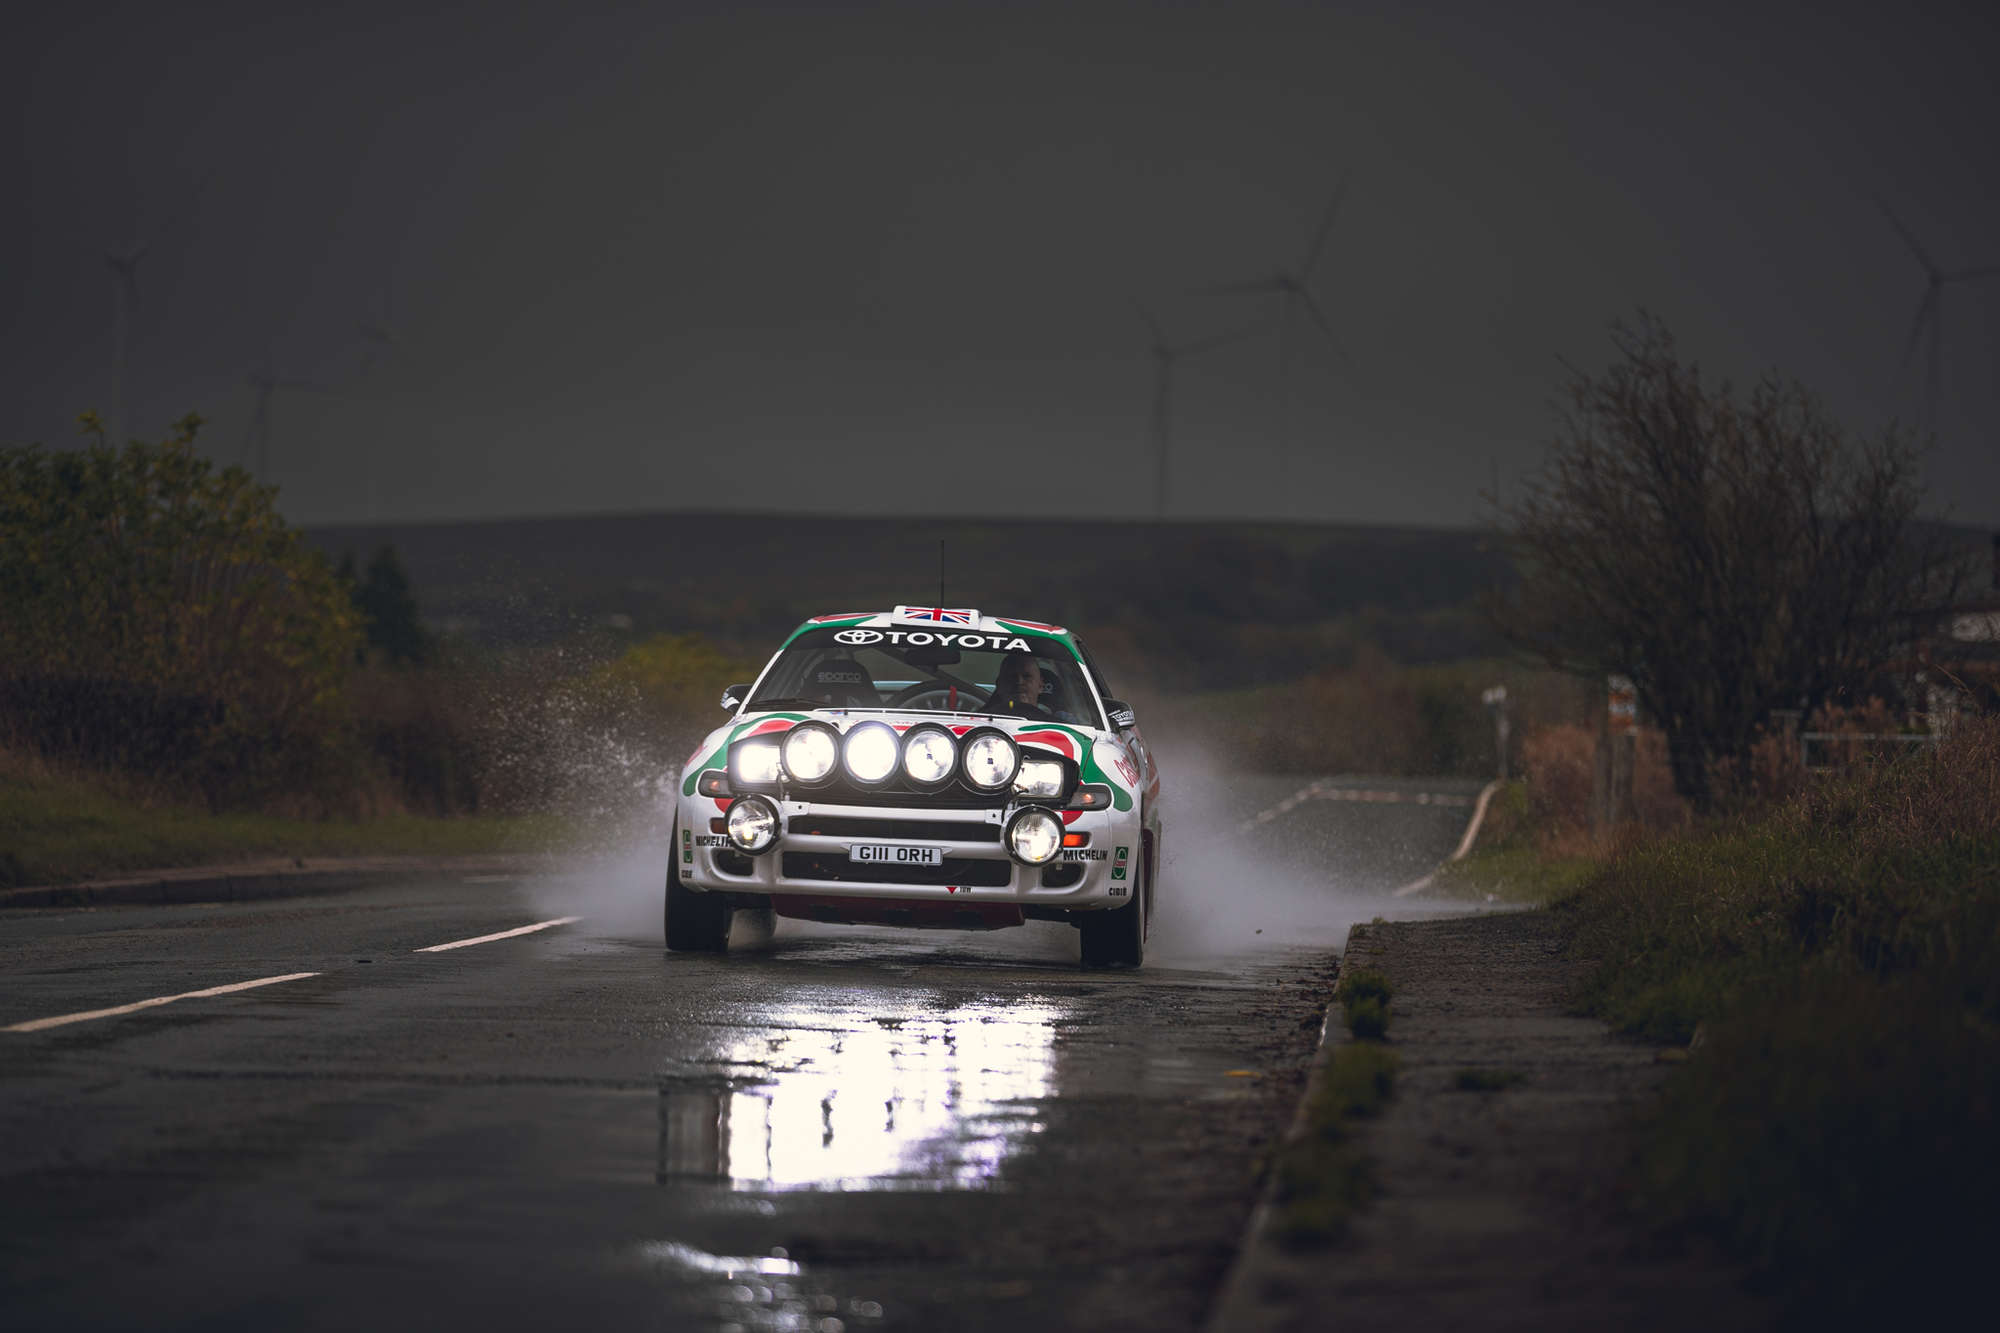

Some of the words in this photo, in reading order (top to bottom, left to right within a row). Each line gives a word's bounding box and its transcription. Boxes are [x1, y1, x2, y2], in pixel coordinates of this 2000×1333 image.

[886, 631, 1032, 653] TOYOTA
[896, 848, 933, 863] ORH
[1063, 850, 1109, 861] MICHELIN
